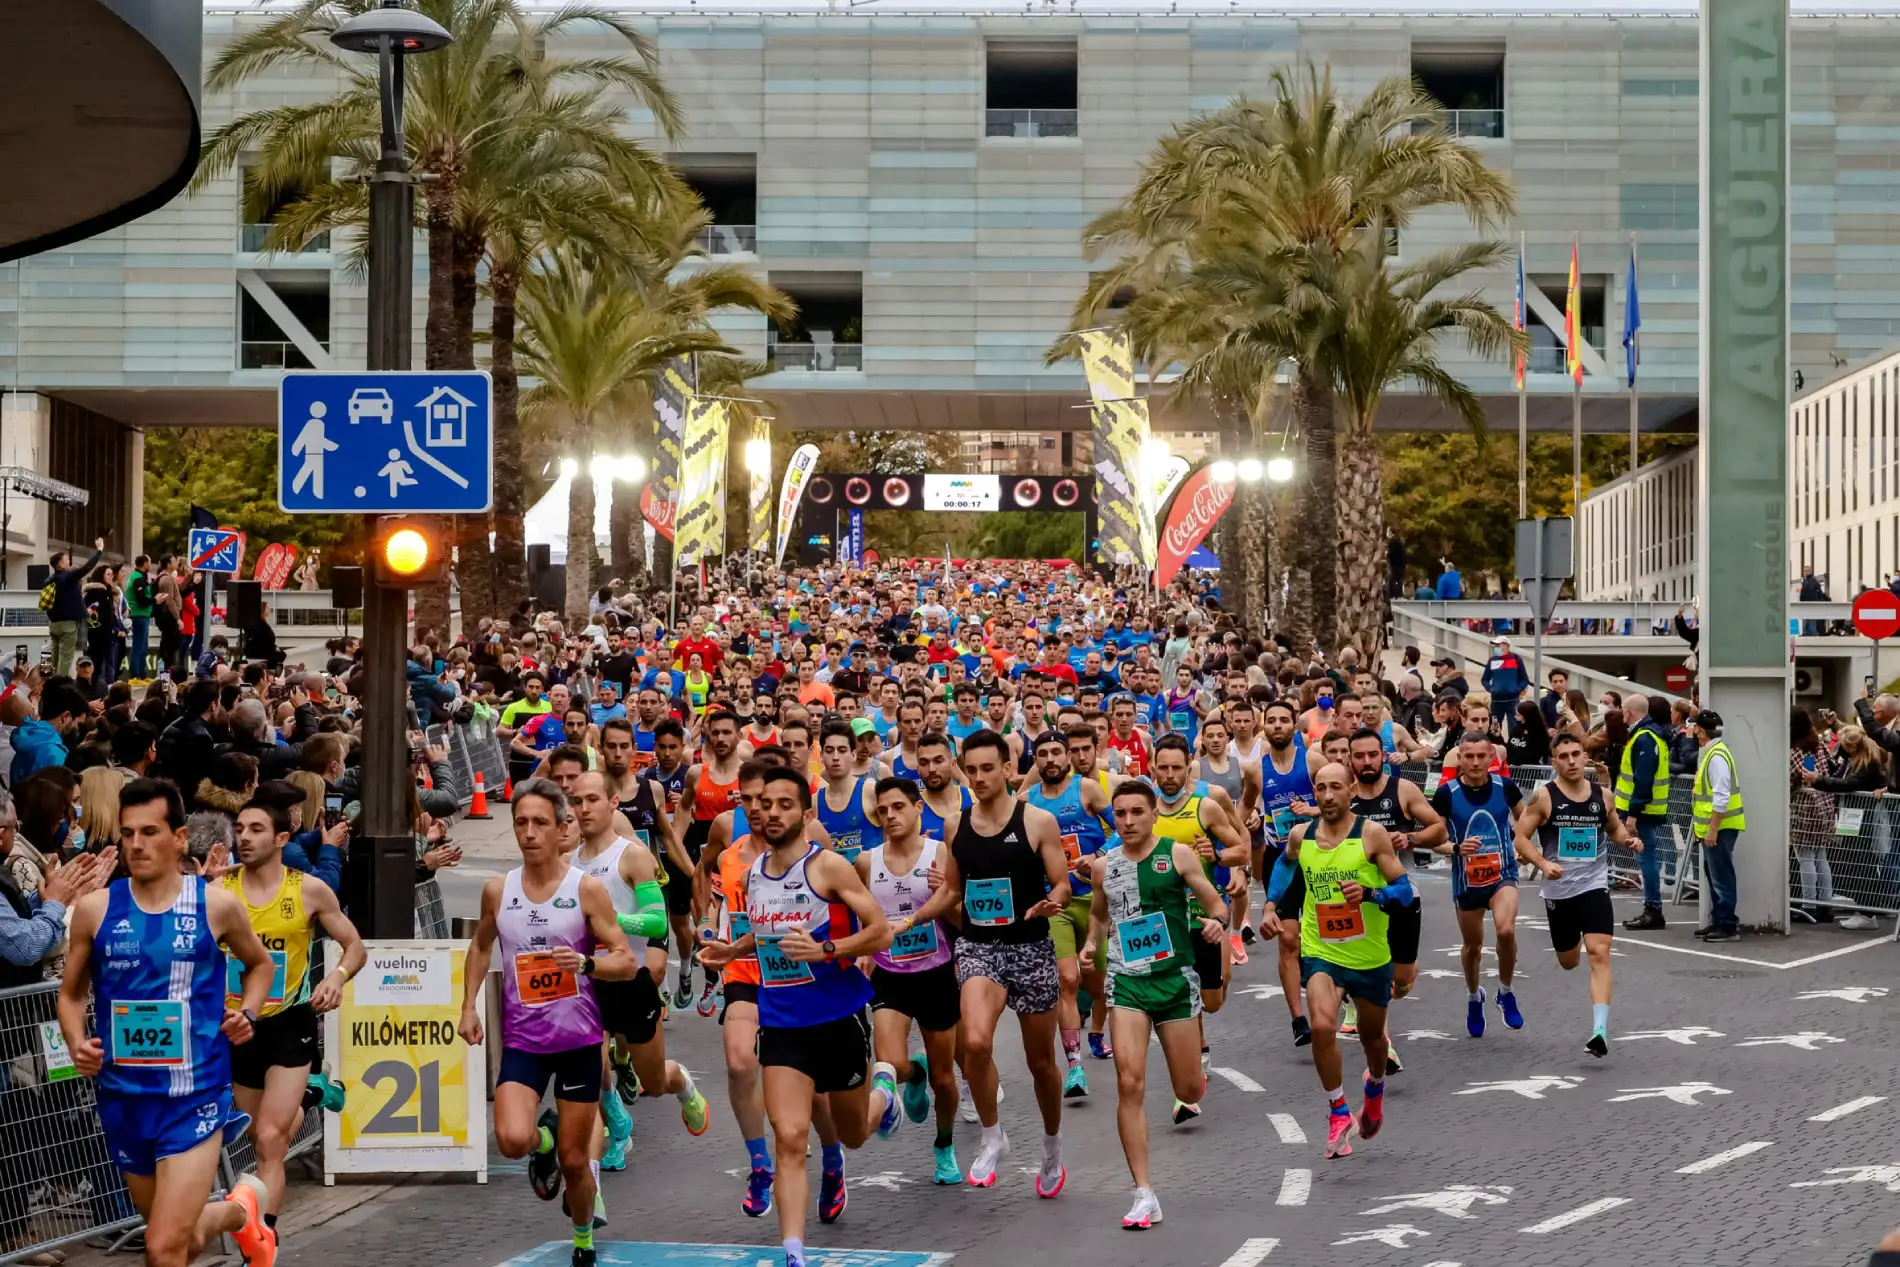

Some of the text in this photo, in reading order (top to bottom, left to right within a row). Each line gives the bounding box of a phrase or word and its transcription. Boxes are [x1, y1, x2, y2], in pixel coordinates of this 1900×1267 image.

[1764, 501, 1781, 634] PARQUE
[1565, 841, 1591, 852] 1989
[1339, 869, 1360, 881] SANZ
[970, 898, 1004, 912] 1976
[1326, 918, 1354, 931] 833
[894, 932, 929, 949] 1574
[1126, 933, 1162, 953] 1949
[374, 955, 428, 973] vueling
[529, 972, 563, 990] 607
[122, 1028, 173, 1047] 1492
[352, 1014, 455, 1047] KILÓMETRO
[131, 1048, 166, 1057] ANDRÉS
[360, 1059, 440, 1134] 21
